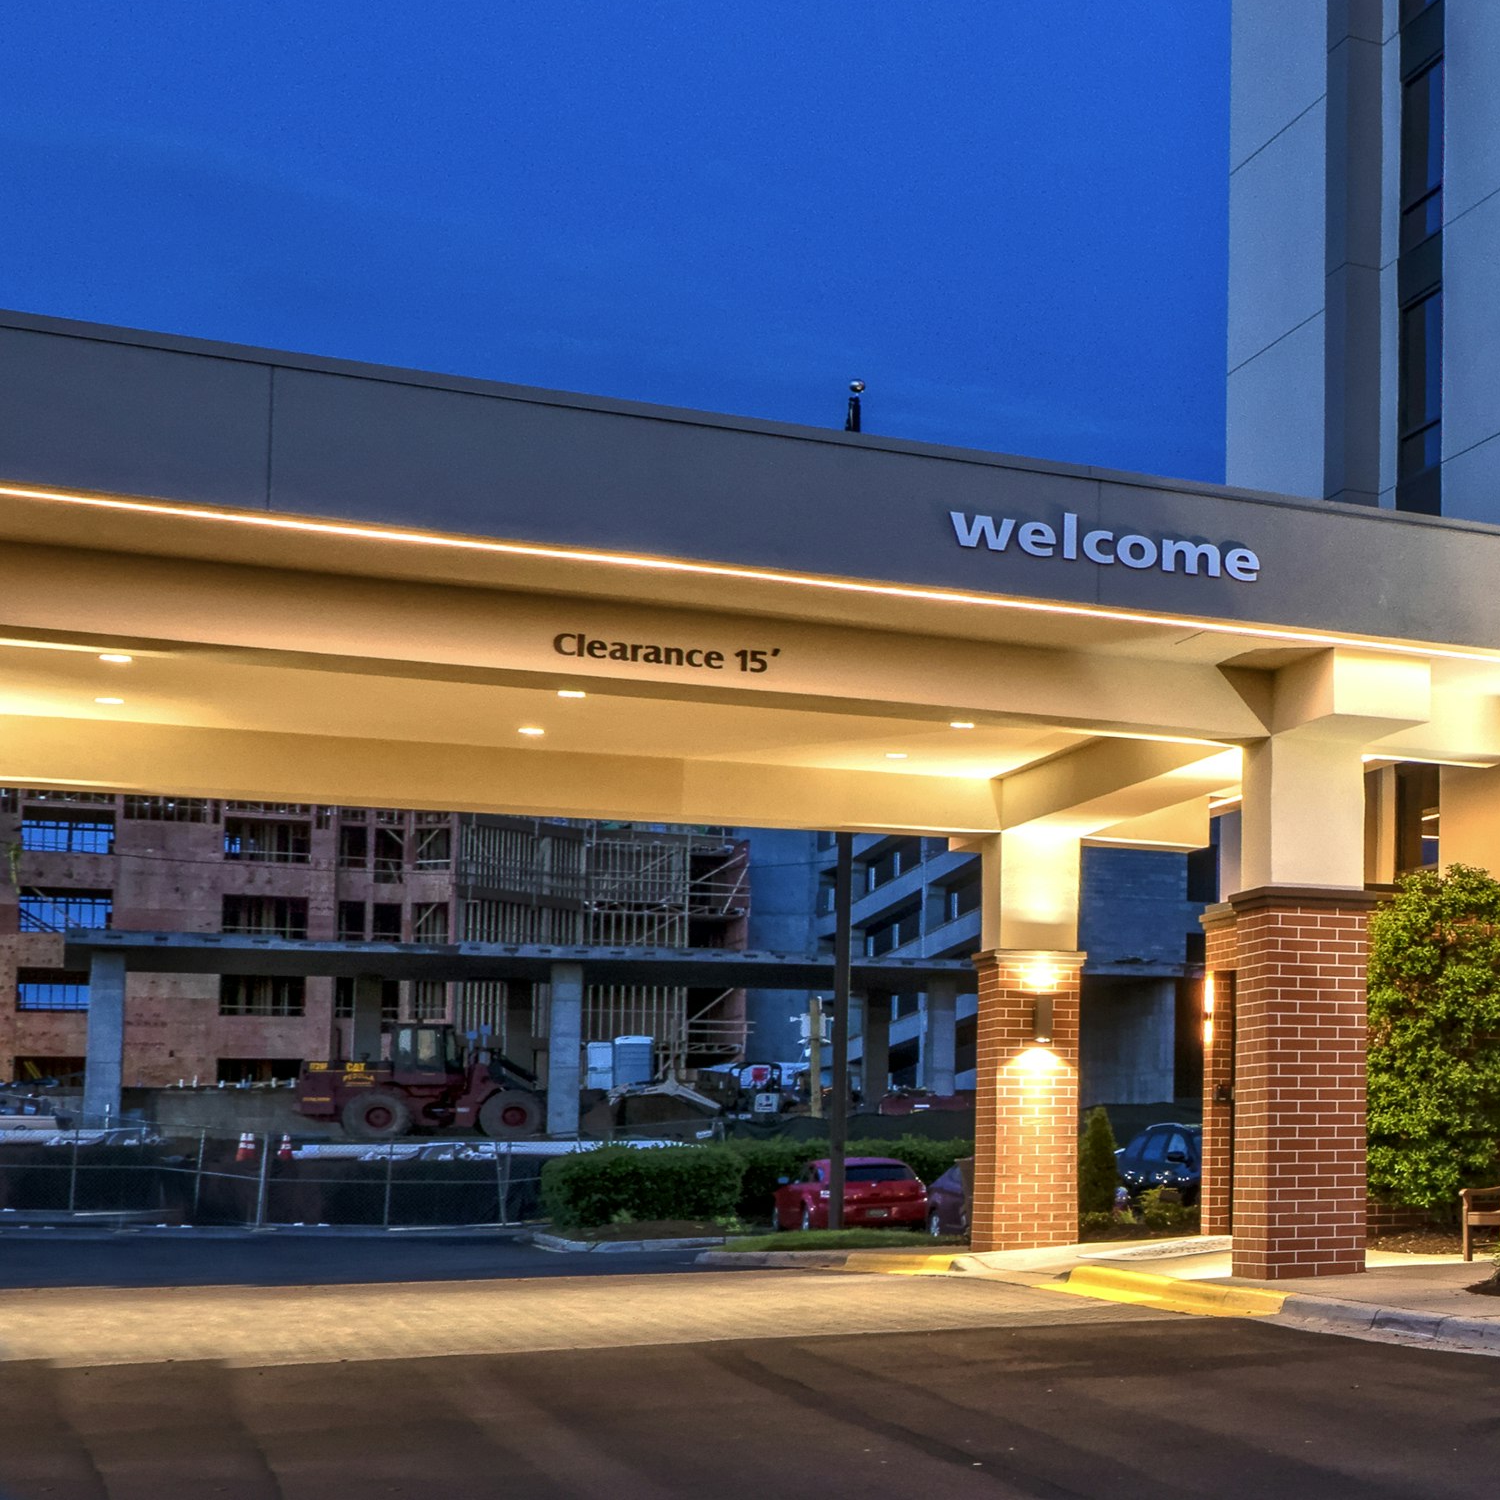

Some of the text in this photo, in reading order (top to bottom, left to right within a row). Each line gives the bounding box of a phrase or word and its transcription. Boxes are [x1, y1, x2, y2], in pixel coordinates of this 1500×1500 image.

[950, 511, 1261, 582] welcome
[553, 633, 725, 669] Clearance
[346, 1062, 366, 1072] CAT
